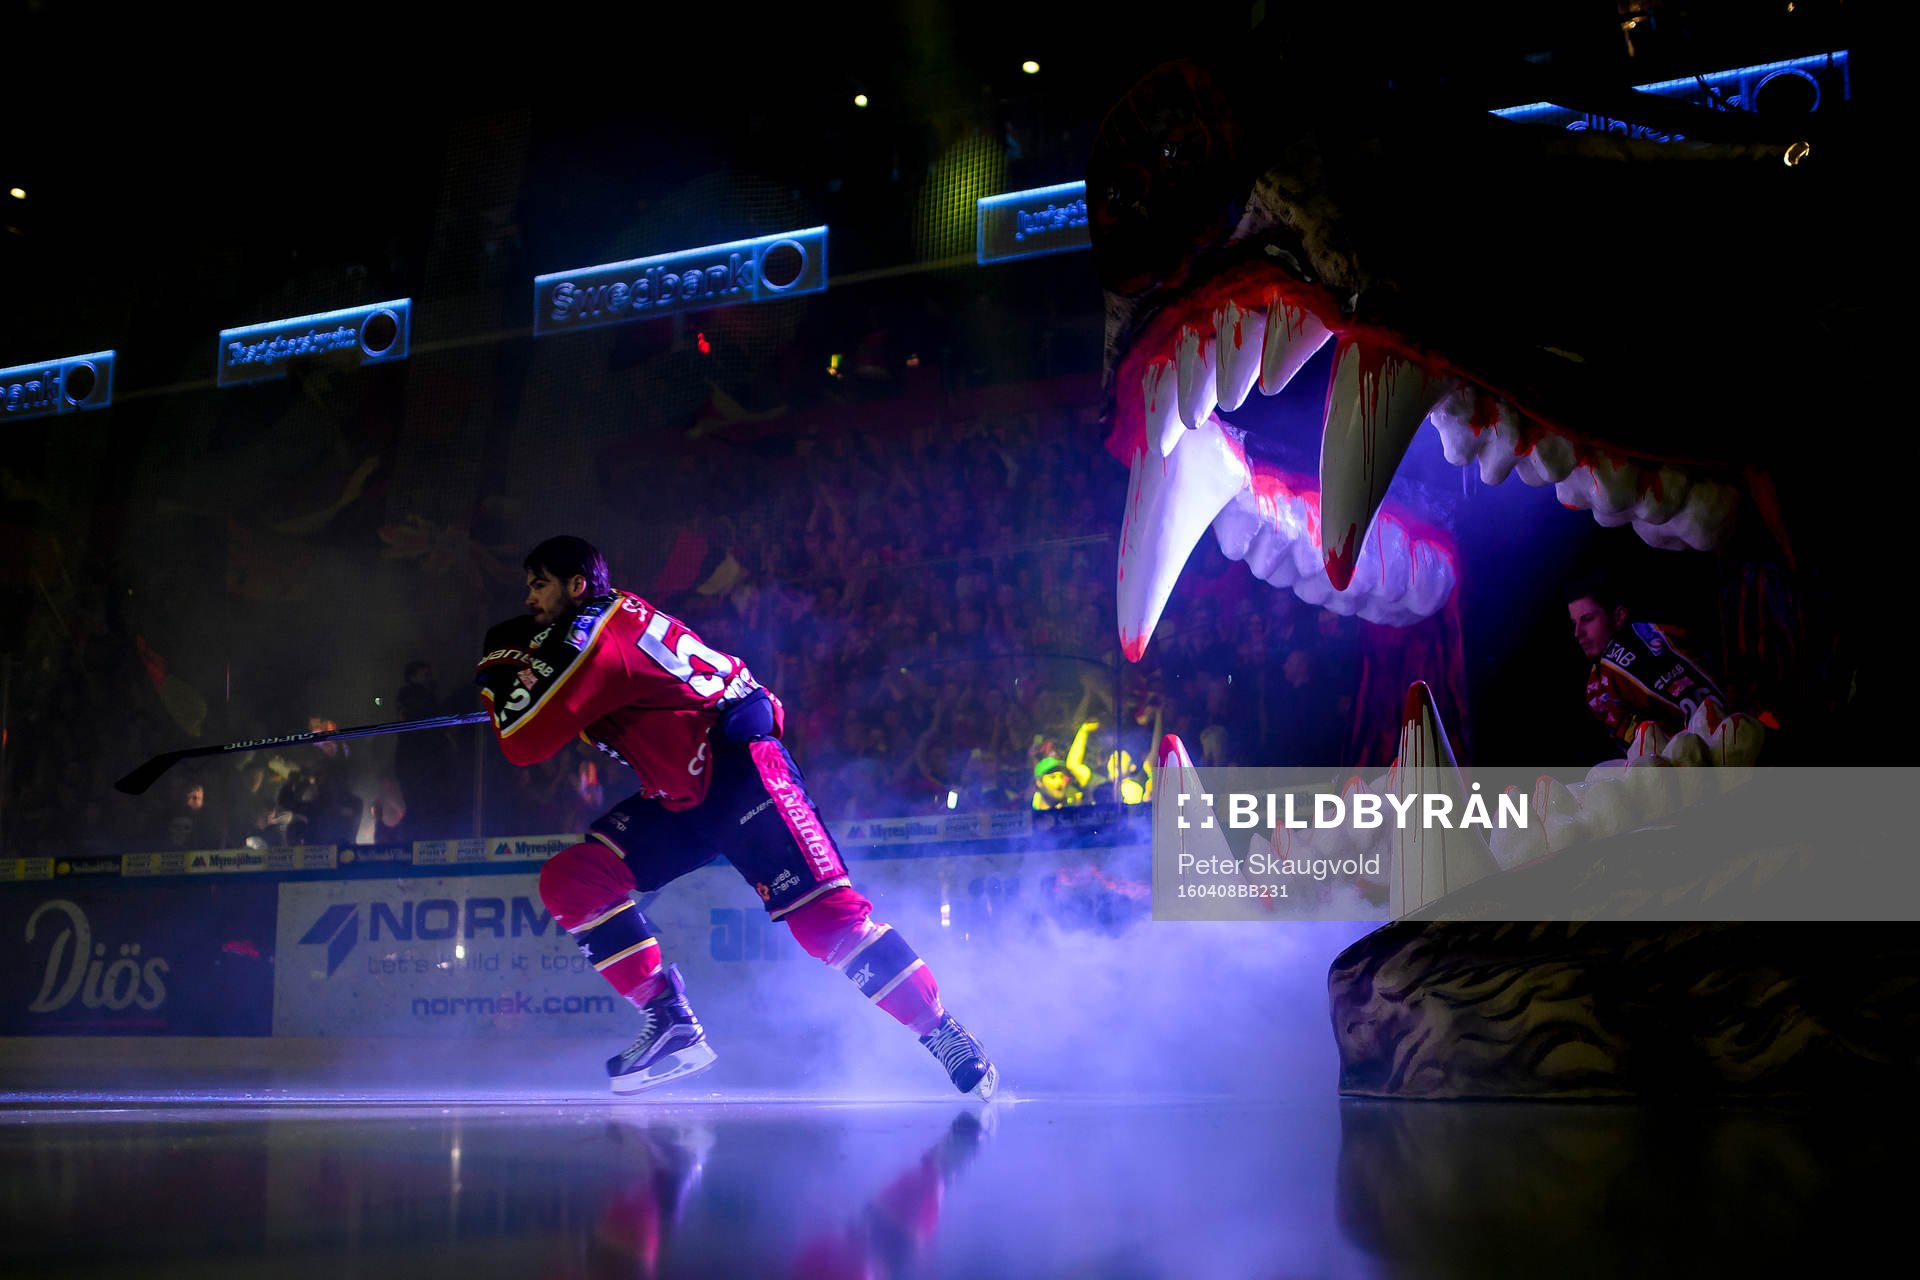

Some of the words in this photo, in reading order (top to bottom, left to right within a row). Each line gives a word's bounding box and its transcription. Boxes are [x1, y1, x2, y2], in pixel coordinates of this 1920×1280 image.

[551, 252, 754, 320] Swedbank
[0, 370, 60, 412] ank
[779, 790, 834, 876] Naiden
[209, 853, 263, 870] Myresjöhus
[24, 898, 170, 1013] Diös
[411, 991, 615, 1016] normek.com
